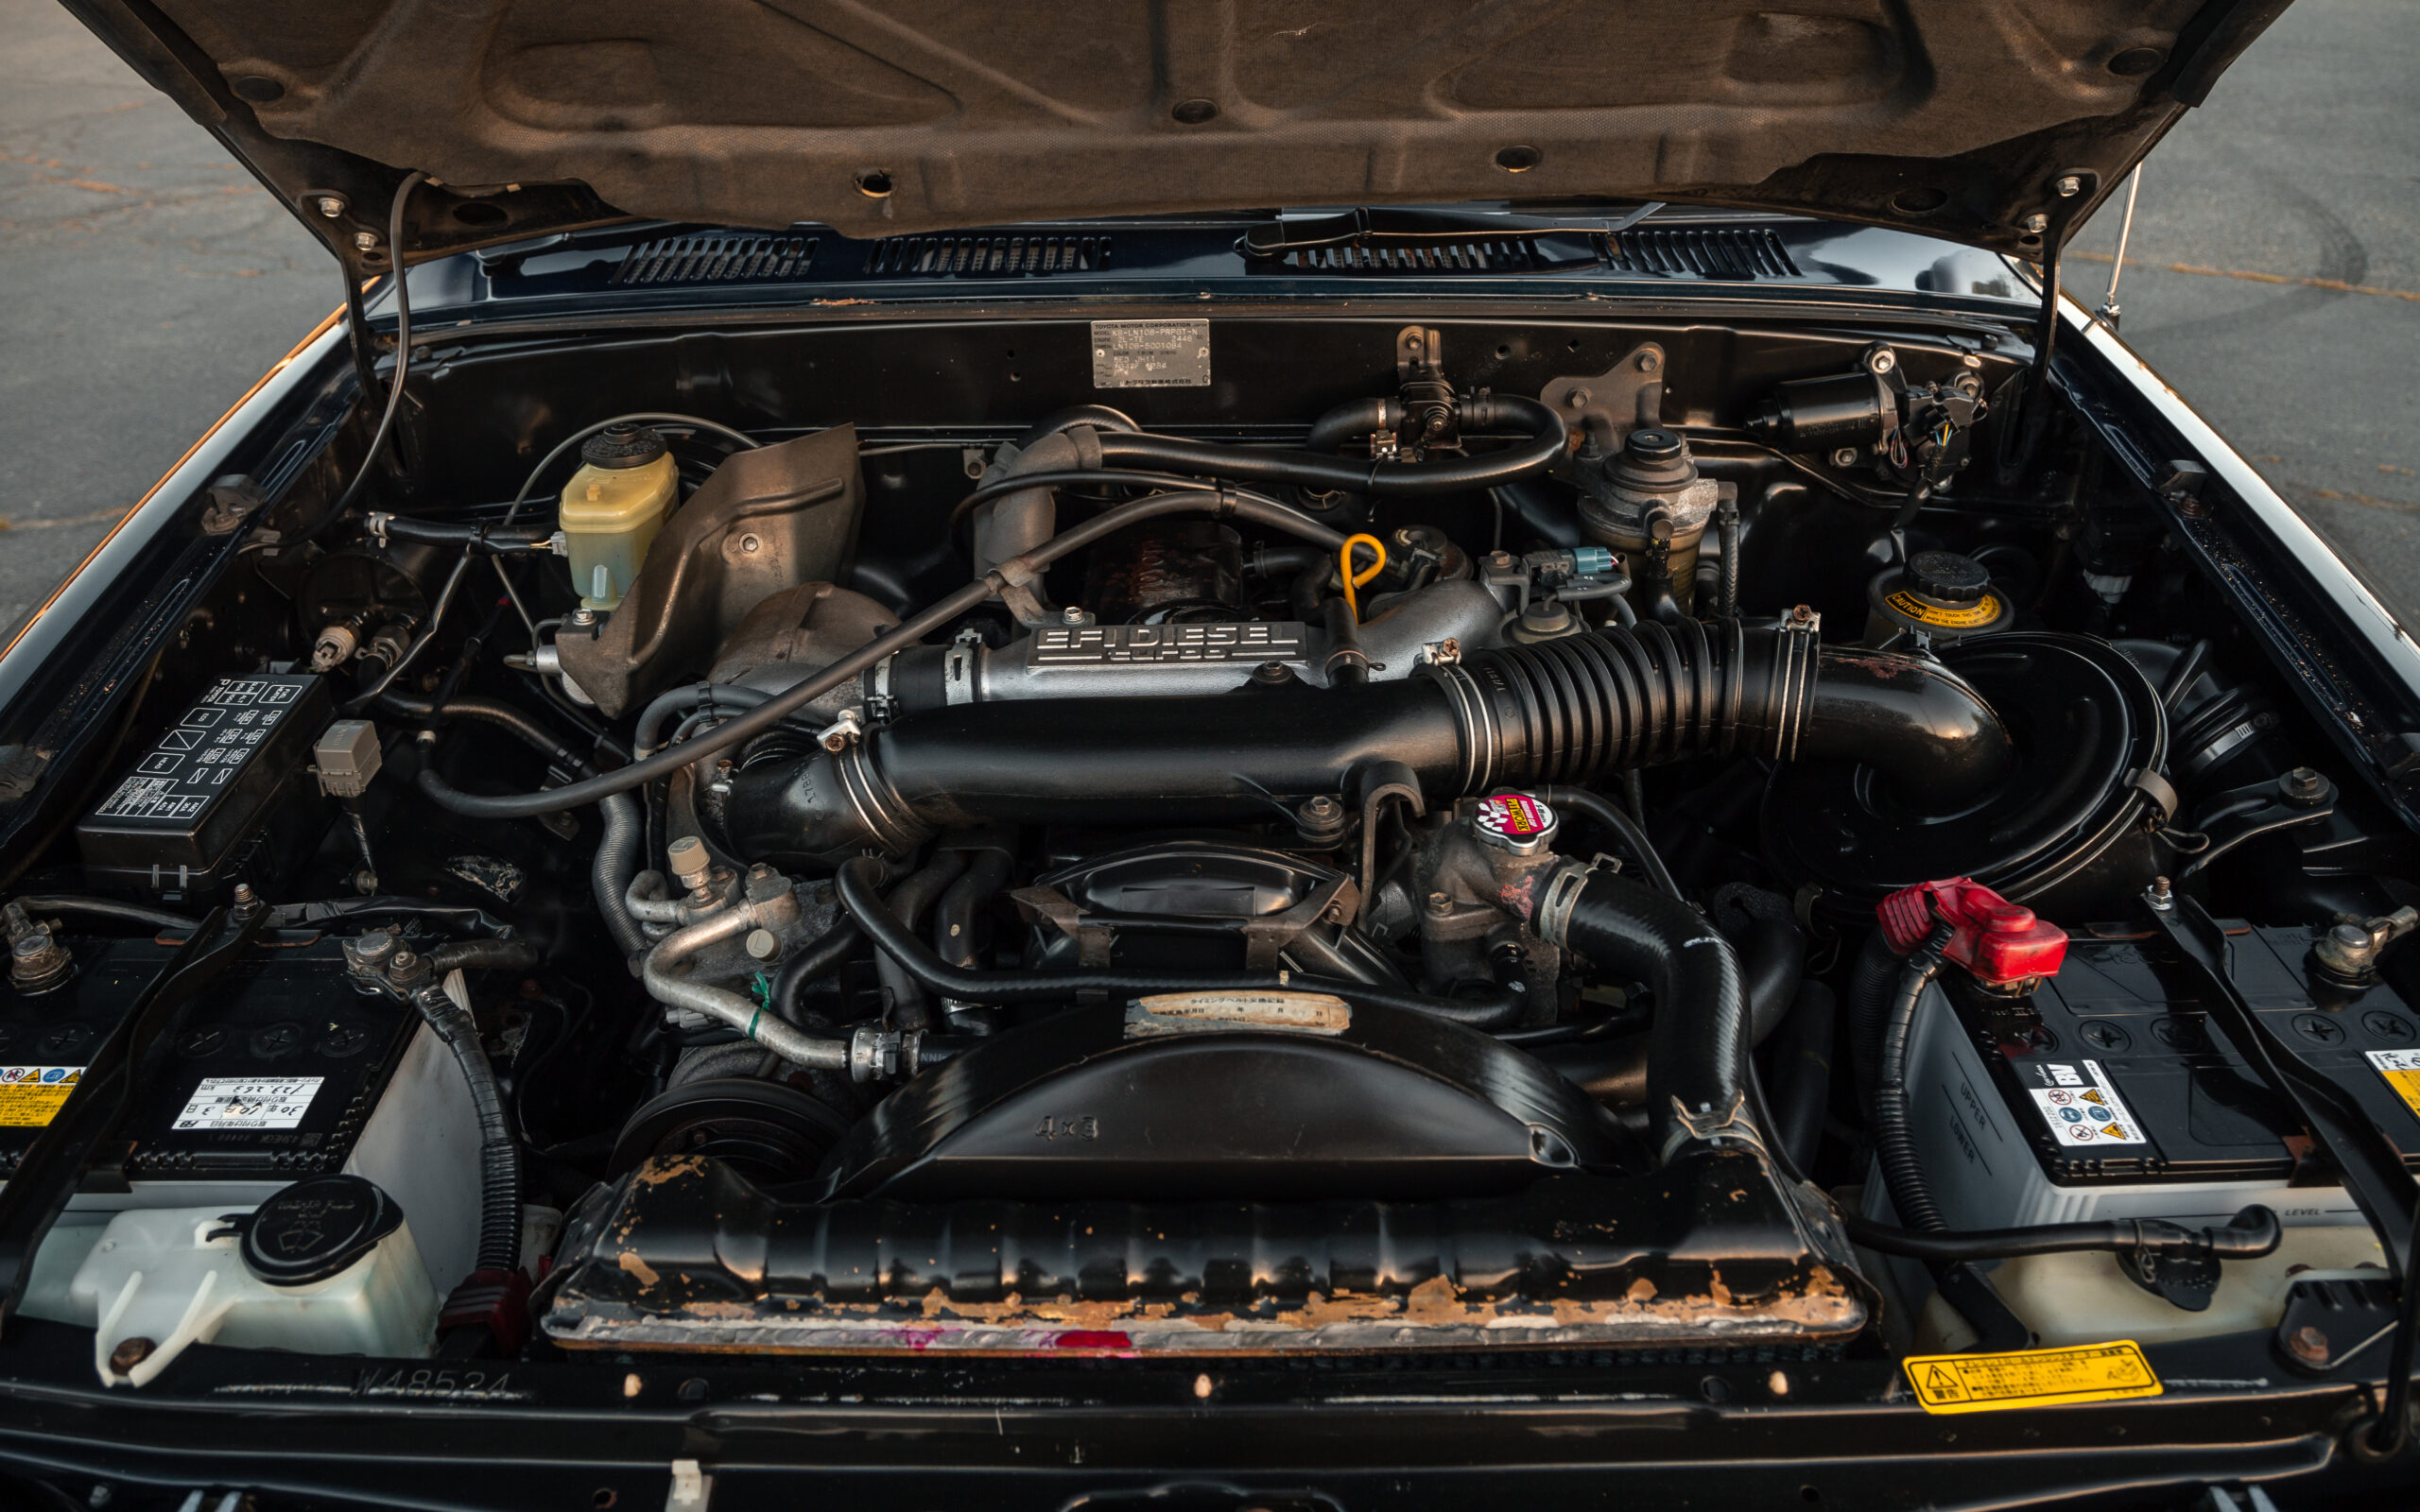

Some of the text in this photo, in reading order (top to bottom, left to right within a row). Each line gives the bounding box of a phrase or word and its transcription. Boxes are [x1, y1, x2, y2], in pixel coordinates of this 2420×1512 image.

[1892, 593, 1926, 617] CAUTION
[276, 688, 291, 699] FUEL
[153, 757, 169, 768] HEAD
[1505, 799, 1530, 831] PITWORK
[752, 933, 765, 955] L
[2046, 1064, 2084, 1085] BV
[186, 1105, 198, 1113] 日
[202, 1107, 215, 1115] 3
[281, 1105, 303, 1116] 30
[1960, 1082, 1986, 1130] UPPER
[1950, 1115, 1974, 1164] LOWER
